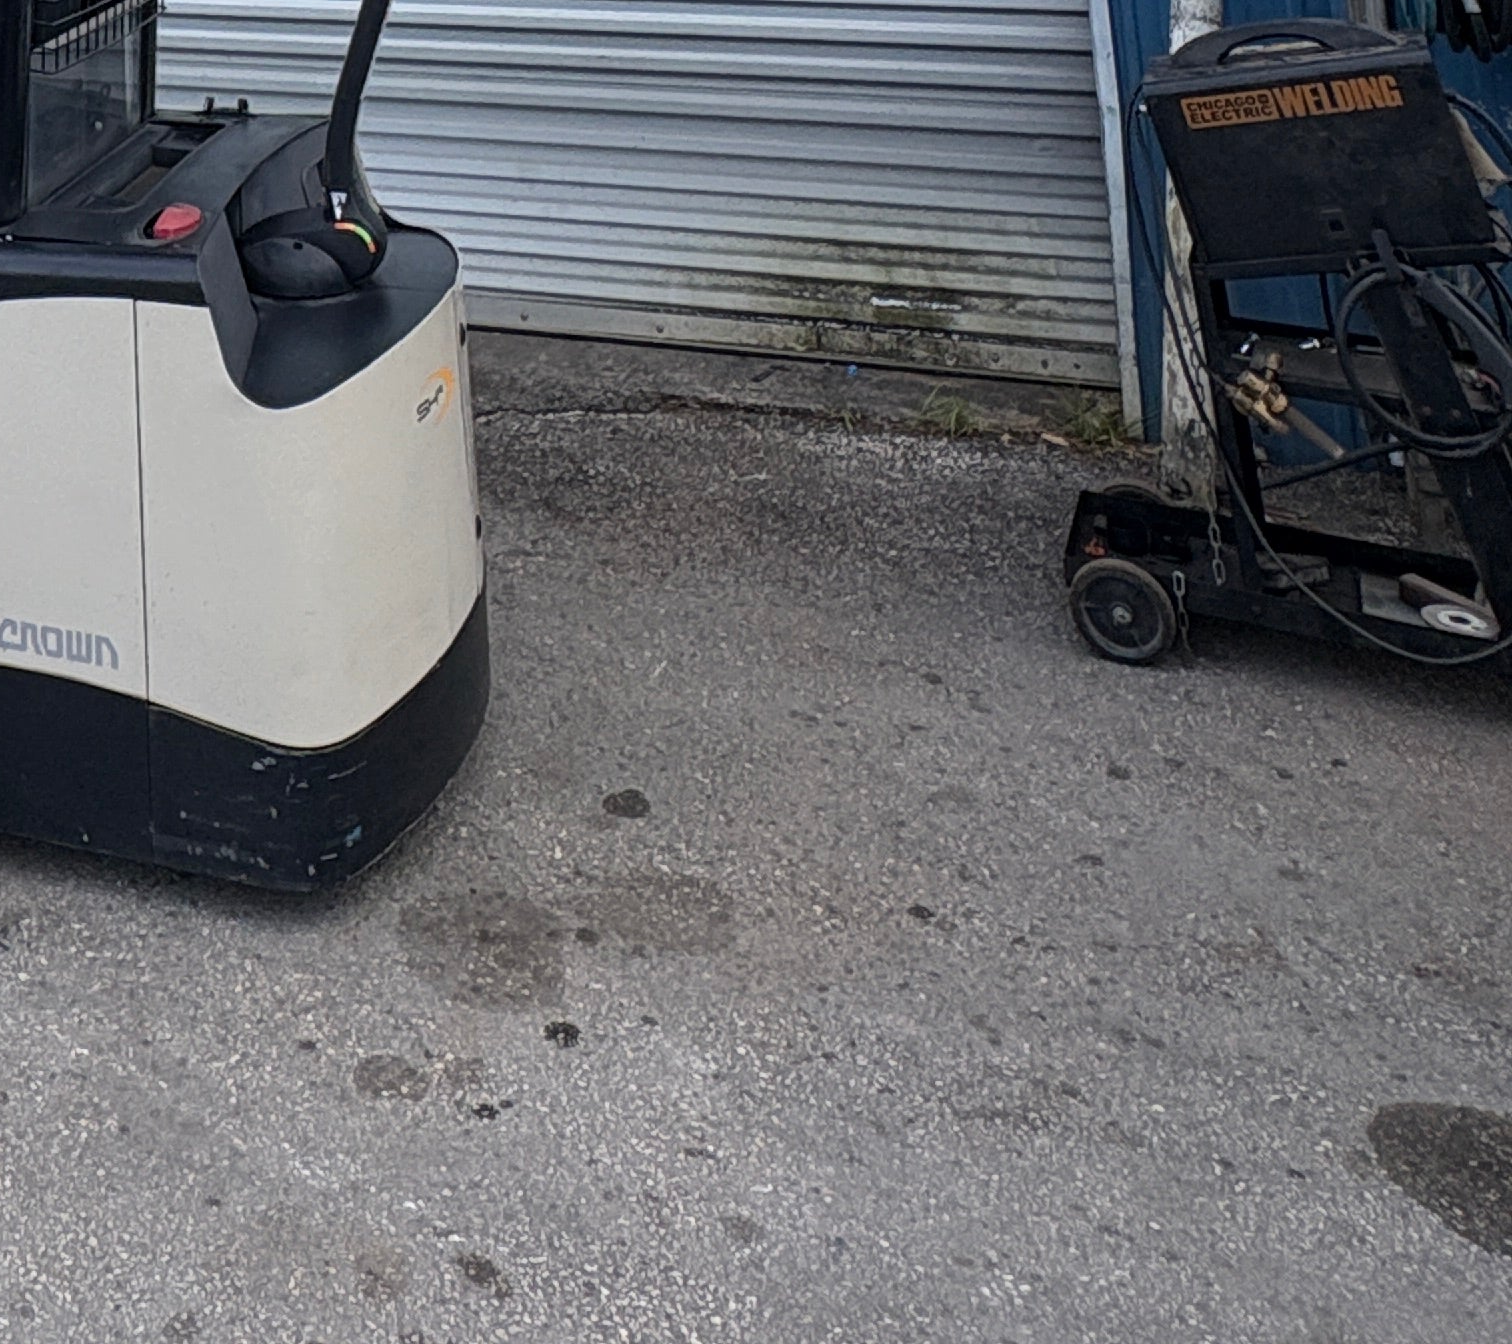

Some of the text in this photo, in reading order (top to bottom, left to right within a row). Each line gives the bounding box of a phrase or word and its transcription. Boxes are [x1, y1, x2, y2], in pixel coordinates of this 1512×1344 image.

[1187, 93, 1256, 113] CHICAGO
[1271, 74, 1404, 119] WELDING
[1189, 103, 1274, 125] ELECTRIC
